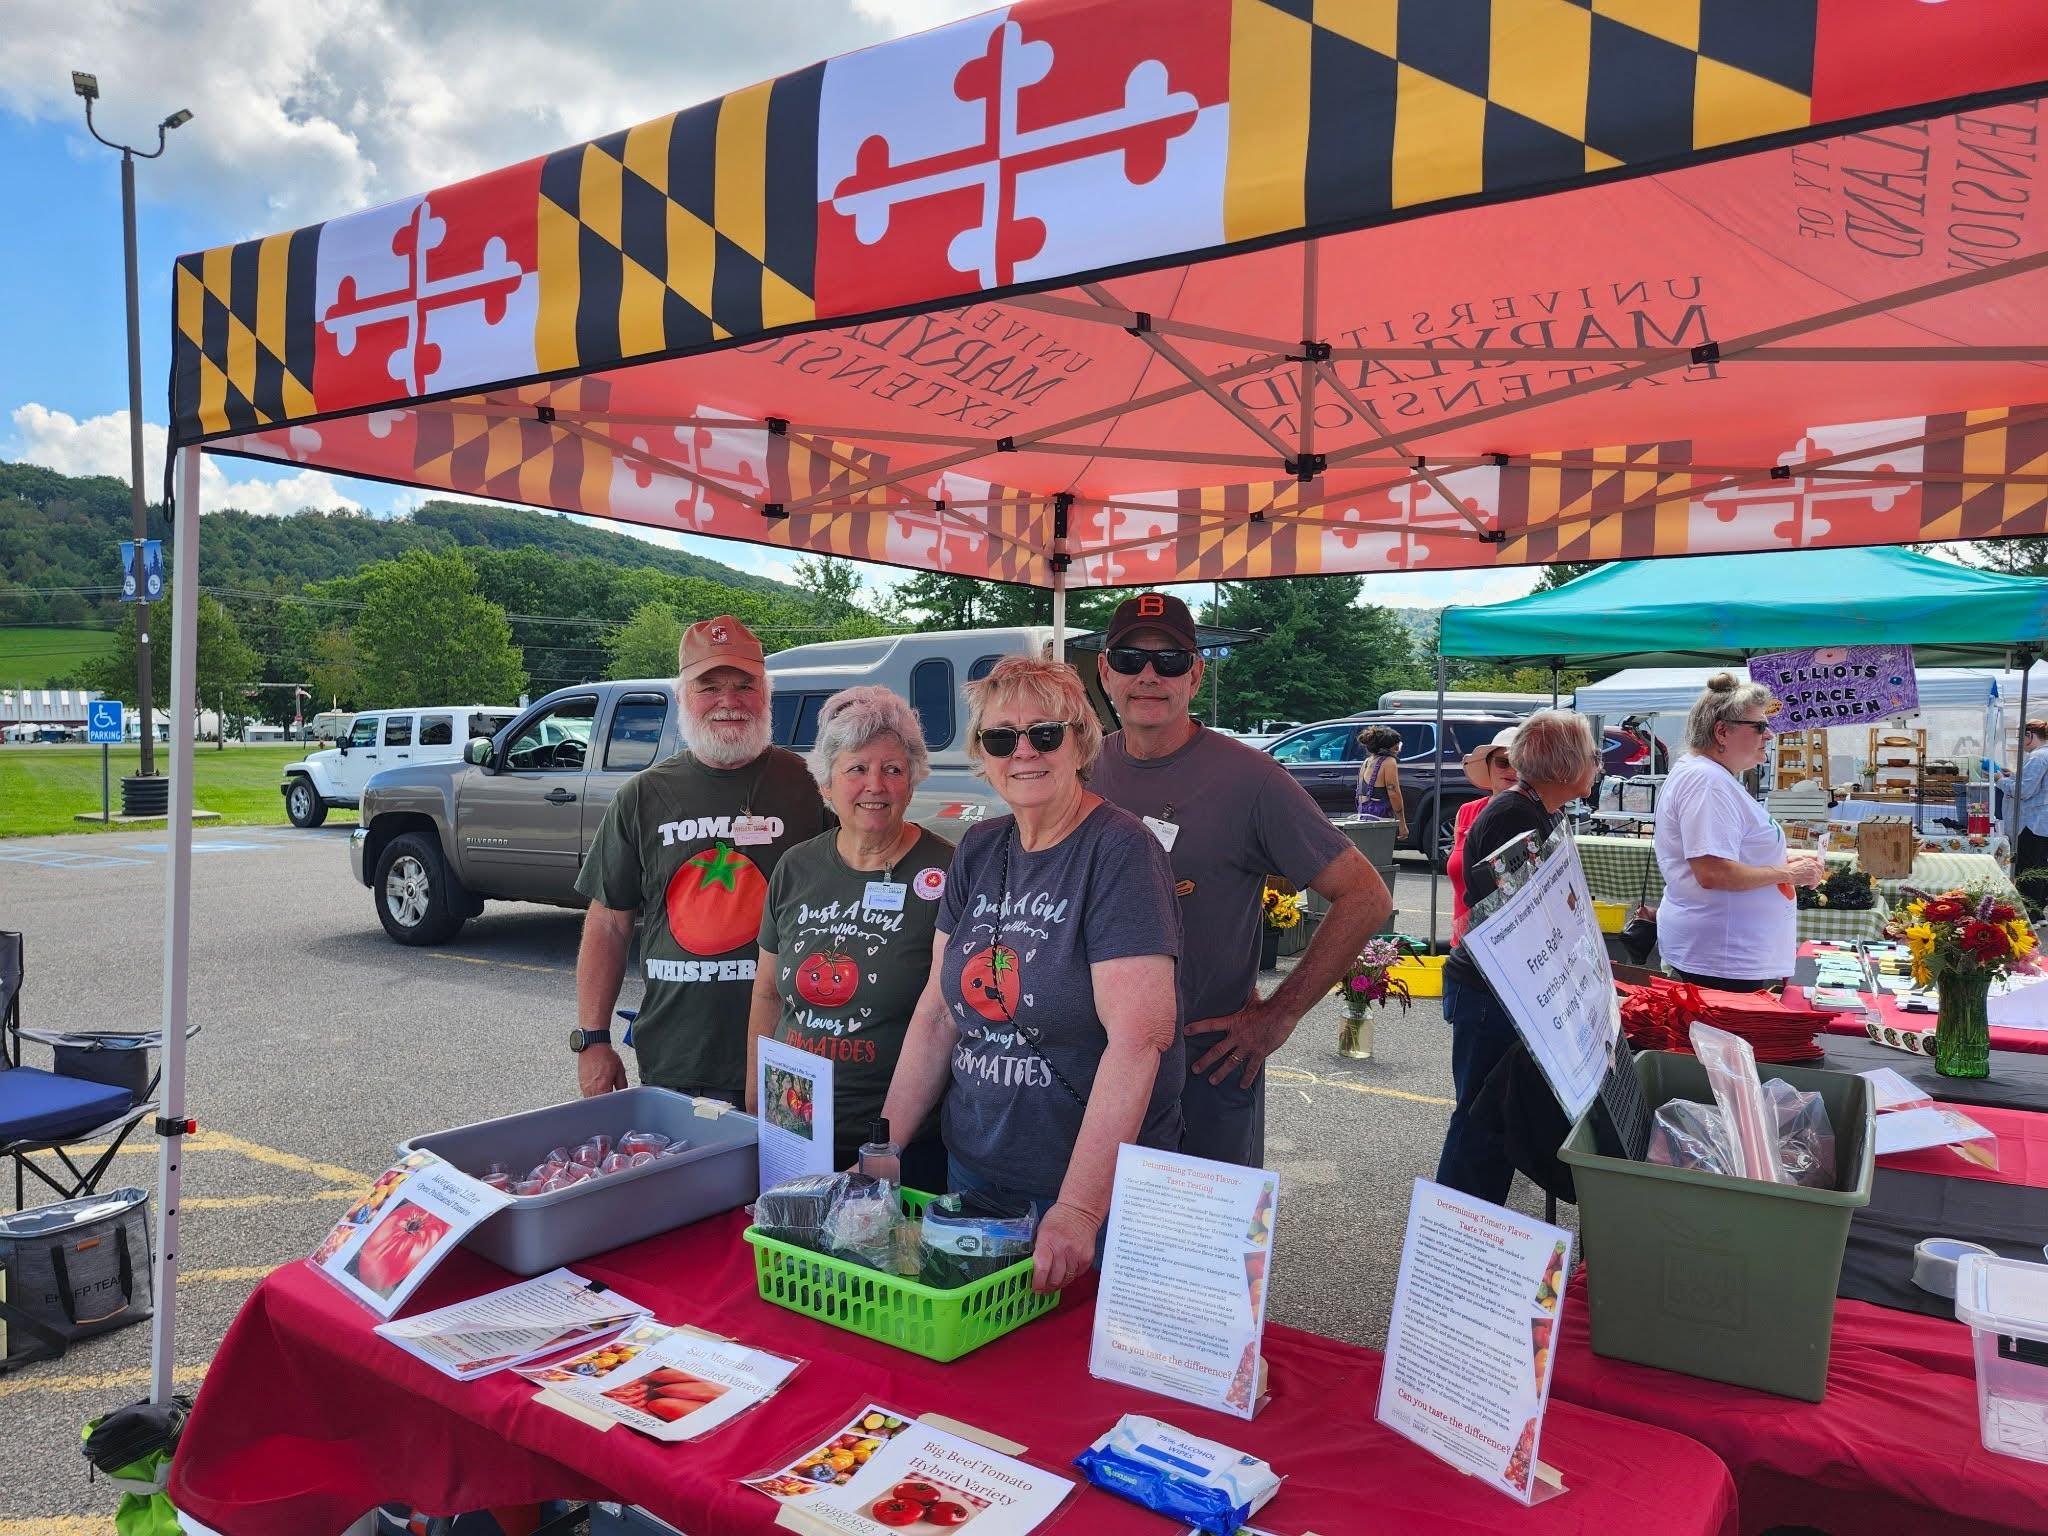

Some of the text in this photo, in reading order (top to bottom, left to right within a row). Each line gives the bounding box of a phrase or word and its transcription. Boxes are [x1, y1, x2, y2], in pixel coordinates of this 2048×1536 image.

[1136, 594, 1165, 617] B
[1780, 665, 1879, 685] ELLIOTS
[1785, 688, 1856, 707] SPACE
[1789, 699, 1881, 723] GARDEN
[90, 730, 121, 742] PARKING
[841, 901, 861, 920] A
[830, 923, 858, 936] WHO
[1526, 948, 1551, 975] Free
[1536, 970, 1569, 1009] EarthBox
[1435, 1198, 1479, 1222] Determining
[1479, 1214, 1507, 1232] Tomato
[1458, 1220, 1505, 1246] Taste Testing
[94, 1274, 121, 1292] TEA
[687, 1346, 754, 1372] San Marzano
[1110, 1339, 1127, 1352] Can
[1127, 1344, 1144, 1357] you
[1168, 1354, 1183, 1367] the
[1183, 1358, 1232, 1380] difference?
[645, 1350, 768, 1396] Open Pollinated Variety
[1397, 1387, 1412, 1403] Can
[1412, 1396, 1427, 1413] you
[1428, 1403, 1448, 1422] taste
[1449, 1414, 1463, 1430] the
[1463, 1422, 1511, 1455] difference?
[1159, 1434, 1217, 1461] 75% ALCOHOL
[1168, 1446, 1194, 1460] WIPES
[923, 1441, 1033, 1492] Big Beef Tomato
[908, 1456, 1019, 1507] Hybrid Variety
